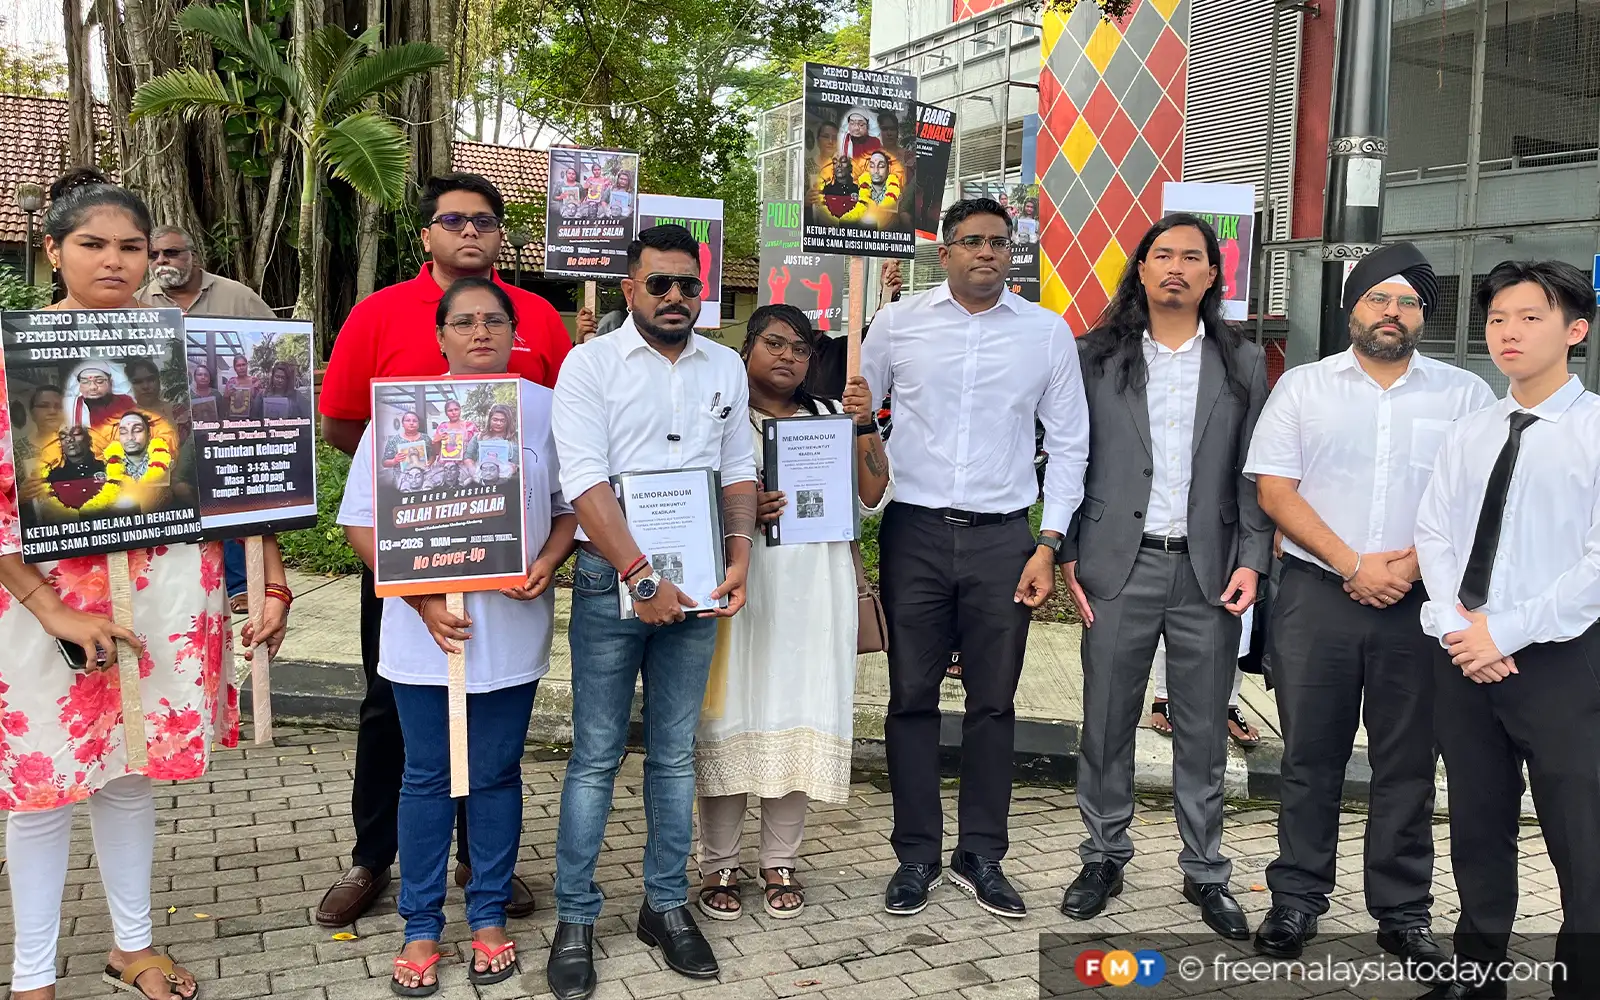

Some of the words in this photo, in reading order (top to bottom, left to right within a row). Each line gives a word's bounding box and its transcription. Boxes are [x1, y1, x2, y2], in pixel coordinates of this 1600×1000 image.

[822, 66, 849, 78] MEMO
[851, 70, 903, 85] BANTAHAN
[813, 79, 879, 95] PEMBUNUHAN
[882, 87, 912, 100] KEJAM
[821, 92, 858, 105] DURIAN
[861, 99, 905, 111] TUNGGAL
[922, 107, 950, 126] BANG
[920, 123, 954, 143] ANAK!!
[766, 202, 800, 228] POLIS
[558, 227, 580, 237] SALAH
[582, 227, 601, 237] TETAP
[602, 227, 624, 236] SALAH
[690, 220, 710, 243] TAK
[806, 225, 826, 235] KETUA
[827, 227, 846, 237] POLIS
[846, 229, 871, 239] MELAKA
[872, 230, 879, 238] DI
[880, 231, 911, 241] REHATKAN
[1217, 215, 1240, 239] TAK
[803, 237, 824, 247] SEMUA
[826, 240, 844, 248] SAMA
[845, 241, 863, 249] DISISI
[864, 241, 915, 253] UNDANG-UNDANG
[567, 257, 577, 266] No
[578, 257, 610, 266] Cover-Up
[783, 255, 813, 266] JUSTICE
[815, 256, 820, 265] ?
[1012, 255, 1033, 265] SALAH
[29, 313, 72, 325] MEMO
[76, 312, 160, 324] BANTAHAN
[824, 308, 834, 319] KE
[835, 307, 841, 318] ?
[16, 329, 123, 344] PEMBUNUHAN
[127, 328, 175, 340] KEJAM
[30, 346, 91, 360] DURIAN
[94, 344, 165, 357] TUNGGAL
[193, 420, 220, 430] Memo
[223, 418, 261, 429] Bantahan
[208, 432, 236, 442] Kejam
[238, 430, 267, 439] Durian
[269, 428, 300, 439] Tunggal
[782, 434, 836, 442] MEMORANDUM
[204, 446, 212, 459] 5
[213, 444, 254, 459] Tuntutan
[256, 441, 297, 456] Keluarga!
[215, 464, 239, 475] Tarikh
[271, 461, 291, 470] Sabtu
[224, 476, 245, 486] Masa
[251, 473, 269, 483] 10.00
[270, 471, 285, 482] pagi
[212, 487, 239, 498] Tempat
[246, 485, 264, 495] Bukit
[265, 484, 285, 493] Aman,
[402, 496, 415, 505] WE
[422, 491, 447, 502] NEED
[454, 486, 497, 498] JUSTICE
[631, 489, 692, 499] MEMORANDUM
[395, 505, 432, 525] SALAH
[435, 502, 467, 519] TETAP
[469, 496, 505, 514] SALAH
[26, 525, 59, 539] KETUA
[61, 522, 91, 535] POLIS
[93, 517, 132, 531] MELAKA
[134, 514, 145, 526] DI
[147, 508, 195, 524] REHATKAN
[23, 541, 59, 556] SEMUA
[61, 536, 90, 551] SAMA
[92, 532, 121, 547] DISISI
[123, 521, 201, 541] UNDANG-UNDANG
[379, 539, 392, 551] 03
[400, 538, 424, 549] 2026
[430, 537, 451, 547] 10AM
[413, 555, 429, 570] No
[432, 548, 485, 567] Cover-Up
